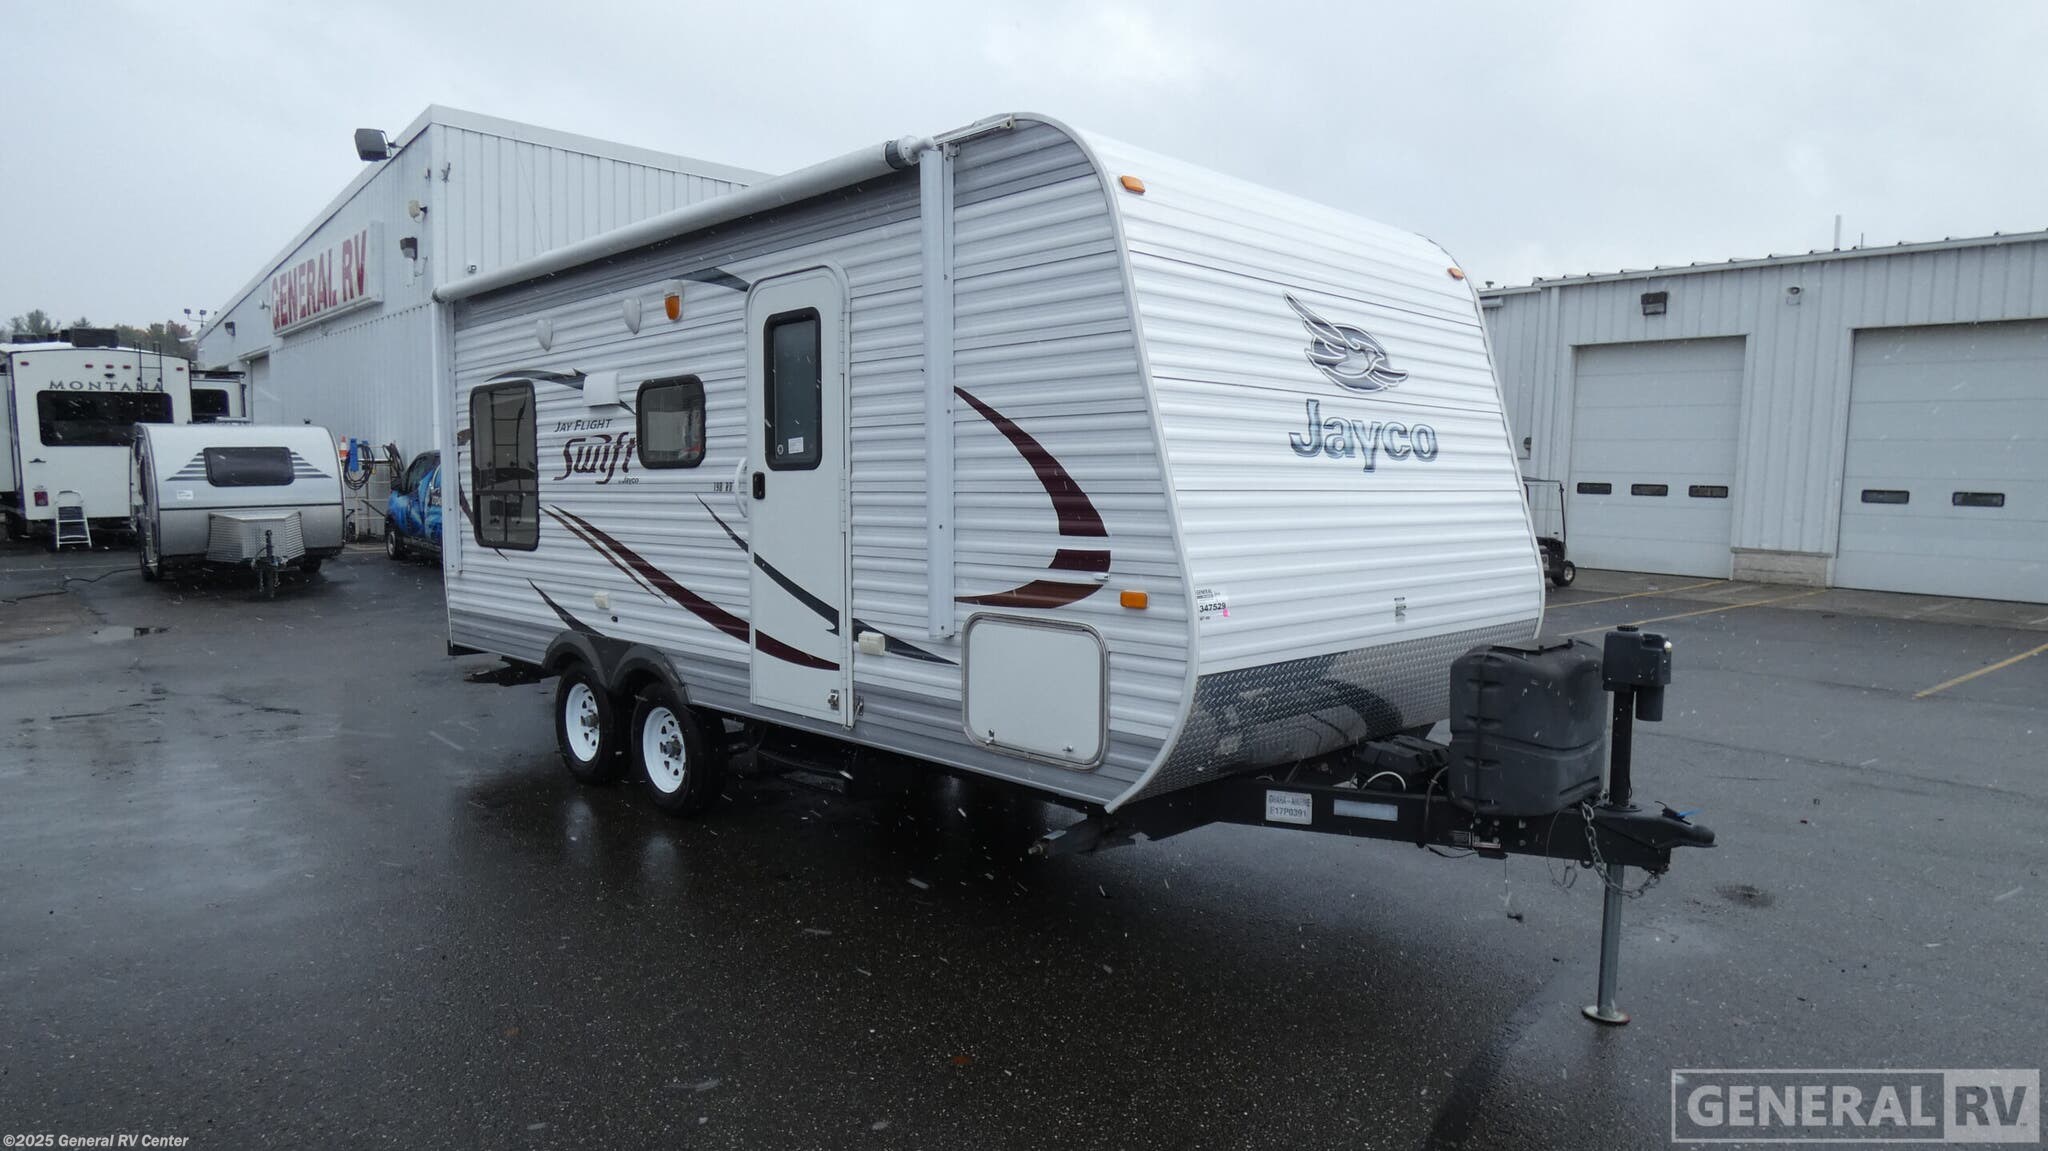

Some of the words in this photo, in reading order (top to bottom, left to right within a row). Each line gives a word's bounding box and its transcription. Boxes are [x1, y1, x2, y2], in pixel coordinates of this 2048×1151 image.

[271, 248, 338, 330] GENERAL
[342, 230, 367, 302] RV
[49, 380, 164, 391] MONTANA
[552, 431, 637, 485] Swift
[1288, 398, 1439, 473] Jayco
[1199, 602, 1227, 613] 347529
